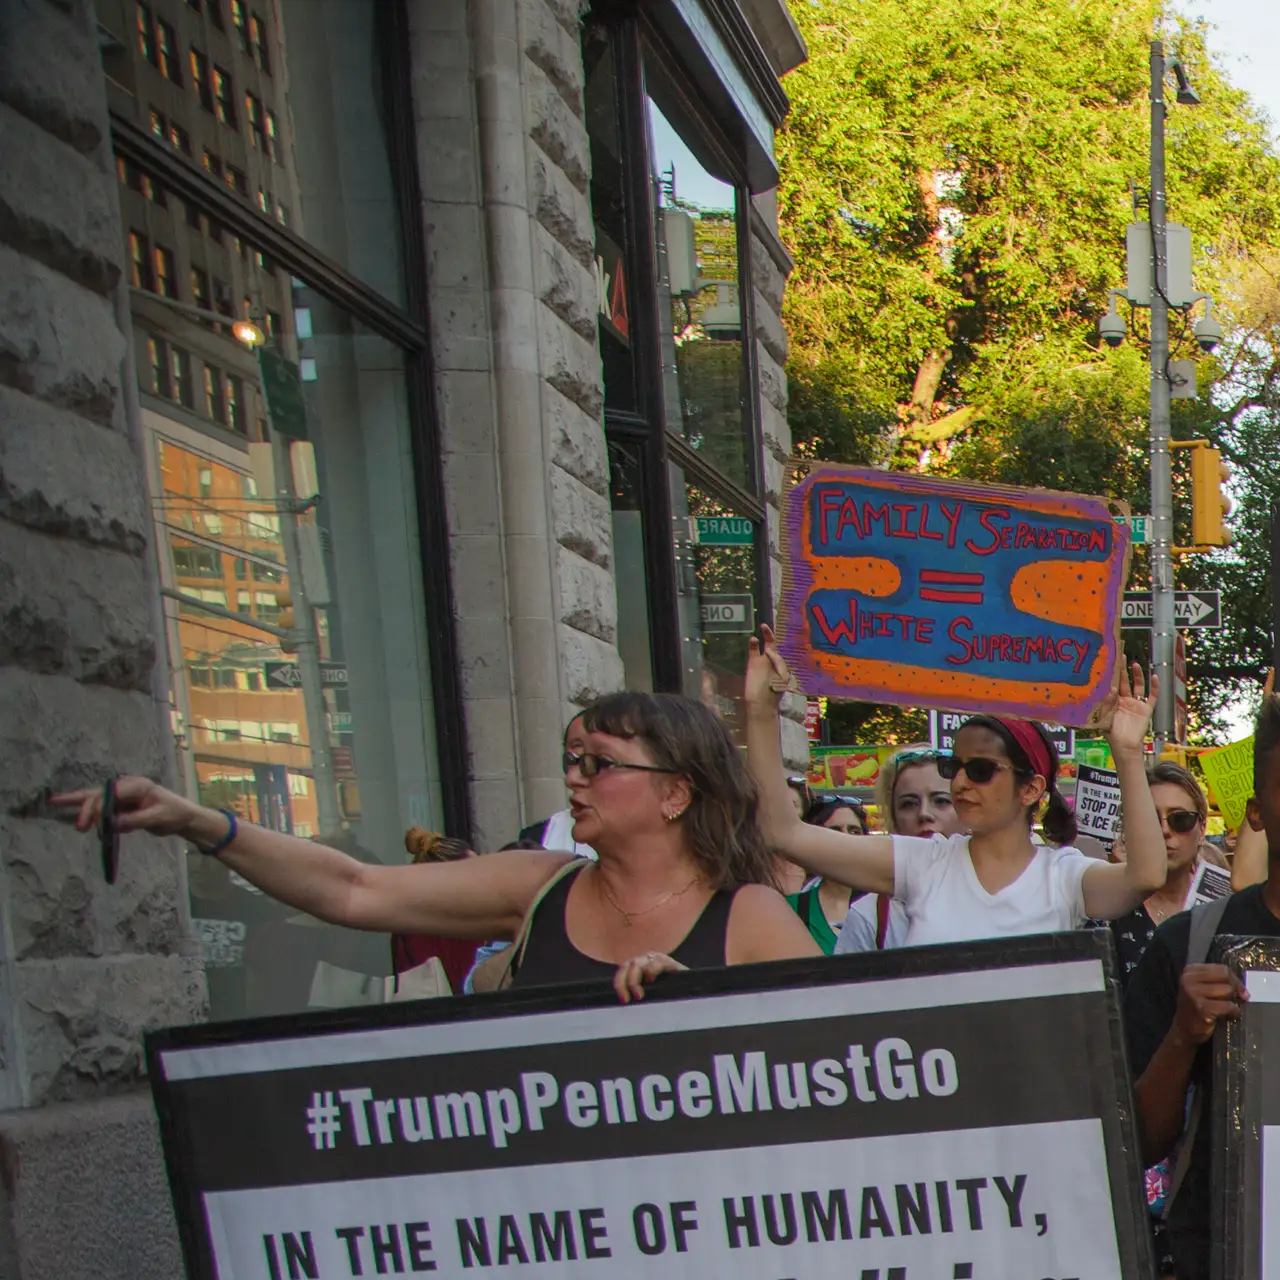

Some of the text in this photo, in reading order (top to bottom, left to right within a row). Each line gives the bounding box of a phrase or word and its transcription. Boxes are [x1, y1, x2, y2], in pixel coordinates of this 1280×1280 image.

[819, 489, 1107, 555] FAMILY SEPARATION
[1125, 603, 1153, 617] ONE
[811, 598, 1090, 674] WHITE SUPREMACY
[1090, 772, 1119, 786] #Trump
[1104, 792, 1119, 801] NAM
[1081, 797, 1107, 814] STOP
[1082, 814, 1090, 826] &
[1092, 816, 1110, 830] ICE
[306, 1036, 960, 1150] #TrumpPenceMustGo
[336, 1222, 437, 1277] THE
[456, 1208, 612, 1270] NAME
[632, 1201, 700, 1256] OF
[723, 1174, 1050, 1249] HUMANITY,
